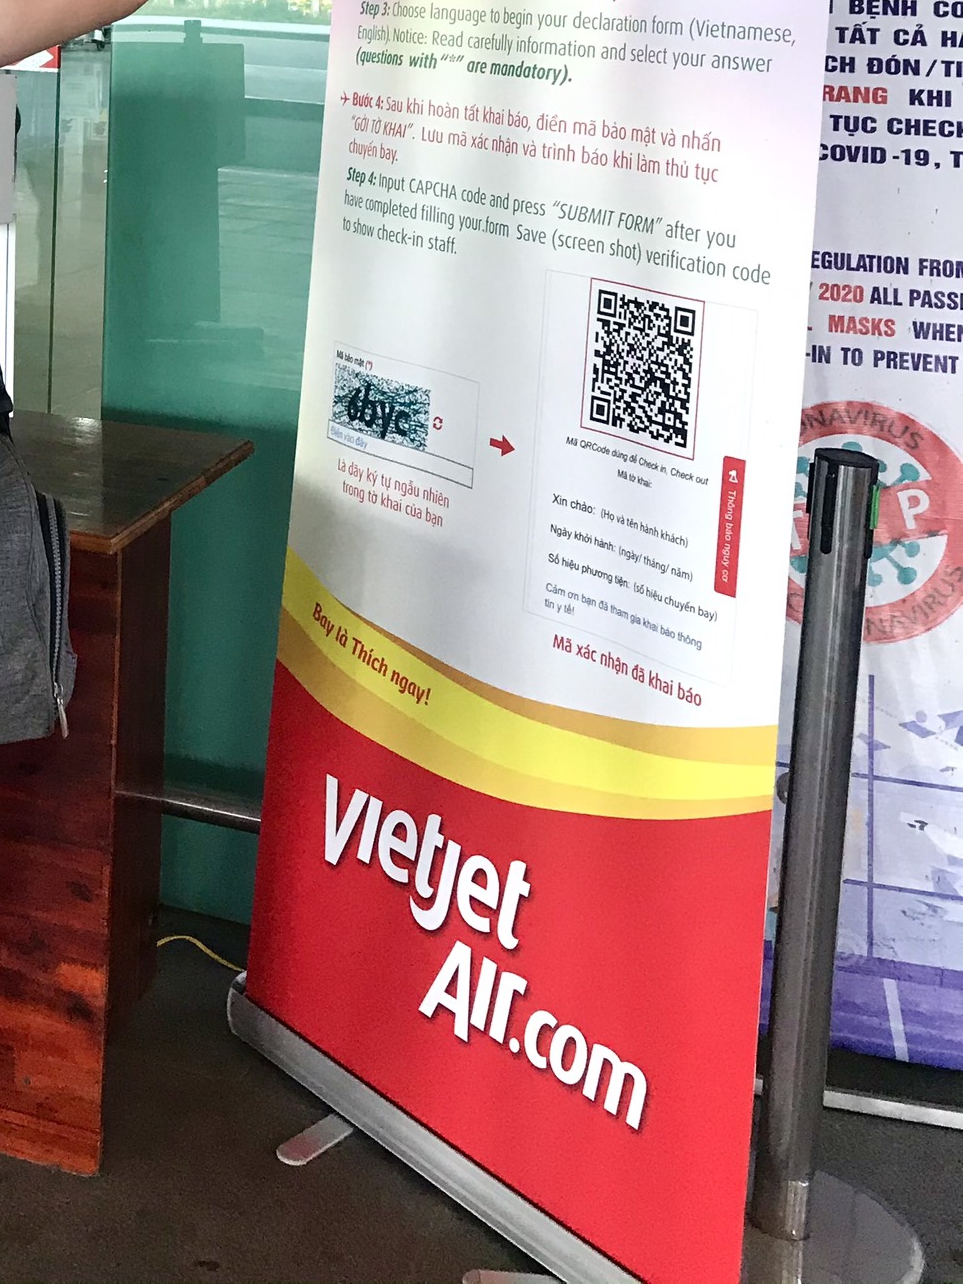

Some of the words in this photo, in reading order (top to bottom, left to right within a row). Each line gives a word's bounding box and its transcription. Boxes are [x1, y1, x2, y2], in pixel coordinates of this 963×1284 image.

[360, 0, 381, 19] Step
[382, 2, 390, 16] 3:
[392, 2, 426, 19] Choose
[430, 3, 487, 26] language
[490, 8, 500, 24] to
[503, 7, 533, 29] begin
[537, 13, 568, 30] your
[573, 11, 647, 34] declaration
[652, 15, 683, 36] form
[689, 17, 796, 47] (Vietnamese,
[835, 21, 880, 45] TẤT
[894, 24, 927, 46] CẢ
[356, 46, 403, 66] (questions
[409, 52, 437, 69] with
[467, 61, 487, 74] are
[490, 61, 572, 86] mandatory).
[393, 28, 427, 45] Notice:
[432, 31, 463, 48] Read
[467, 33, 513, 56] carefully
[516, 36, 595, 58] information
[601, 43, 626, 61] and
[630, 44, 667, 64] select
[672, 51, 706, 70] your
[711, 54, 773, 73] answer
[909, 88, 952, 107] KHI
[830, 115, 877, 136] TỤC
[347, 167, 365, 187] Step
[365, 171, 377, 186] 4:
[379, 173, 405, 193] Input
[409, 178, 457, 201] CAPCHA
[461, 187, 486, 206] code
[489, 193, 509, 210] and
[513, 197, 546, 217] press
[665, 221, 701, 243] after
[707, 230, 736, 249] you
[343, 216, 351, 232] to
[353, 218, 374, 238] show
[377, 225, 424, 248] check-in
[428, 236, 457, 255] staff.
[344, 189, 363, 209] have
[365, 198, 417, 220] completed
[421, 205, 455, 230] filling
[517, 224, 546, 245] Save
[552, 228, 605, 254] (screen
[609, 239, 642, 266] shot)
[646, 249, 726, 278] verification
[732, 264, 771, 285] code
[818, 283, 864, 303] 2020
[870, 286, 902, 306] ALL
[828, 315, 896, 337] MASKS
[841, 347, 863, 366] TO
[873, 350, 959, 374] PREVENT
[312, 601, 335, 644] Bay
[336, 622, 348, 649] là
[351, 636, 388, 678] Thích
[391, 666, 432, 707] ngay!
[553, 634, 572, 653] Mã
[576, 645, 596, 662] xác
[600, 652, 628, 675] nhận
[631, 664, 645, 684] đã
[649, 671, 673, 696] khai
[677, 682, 702, 706] báo
